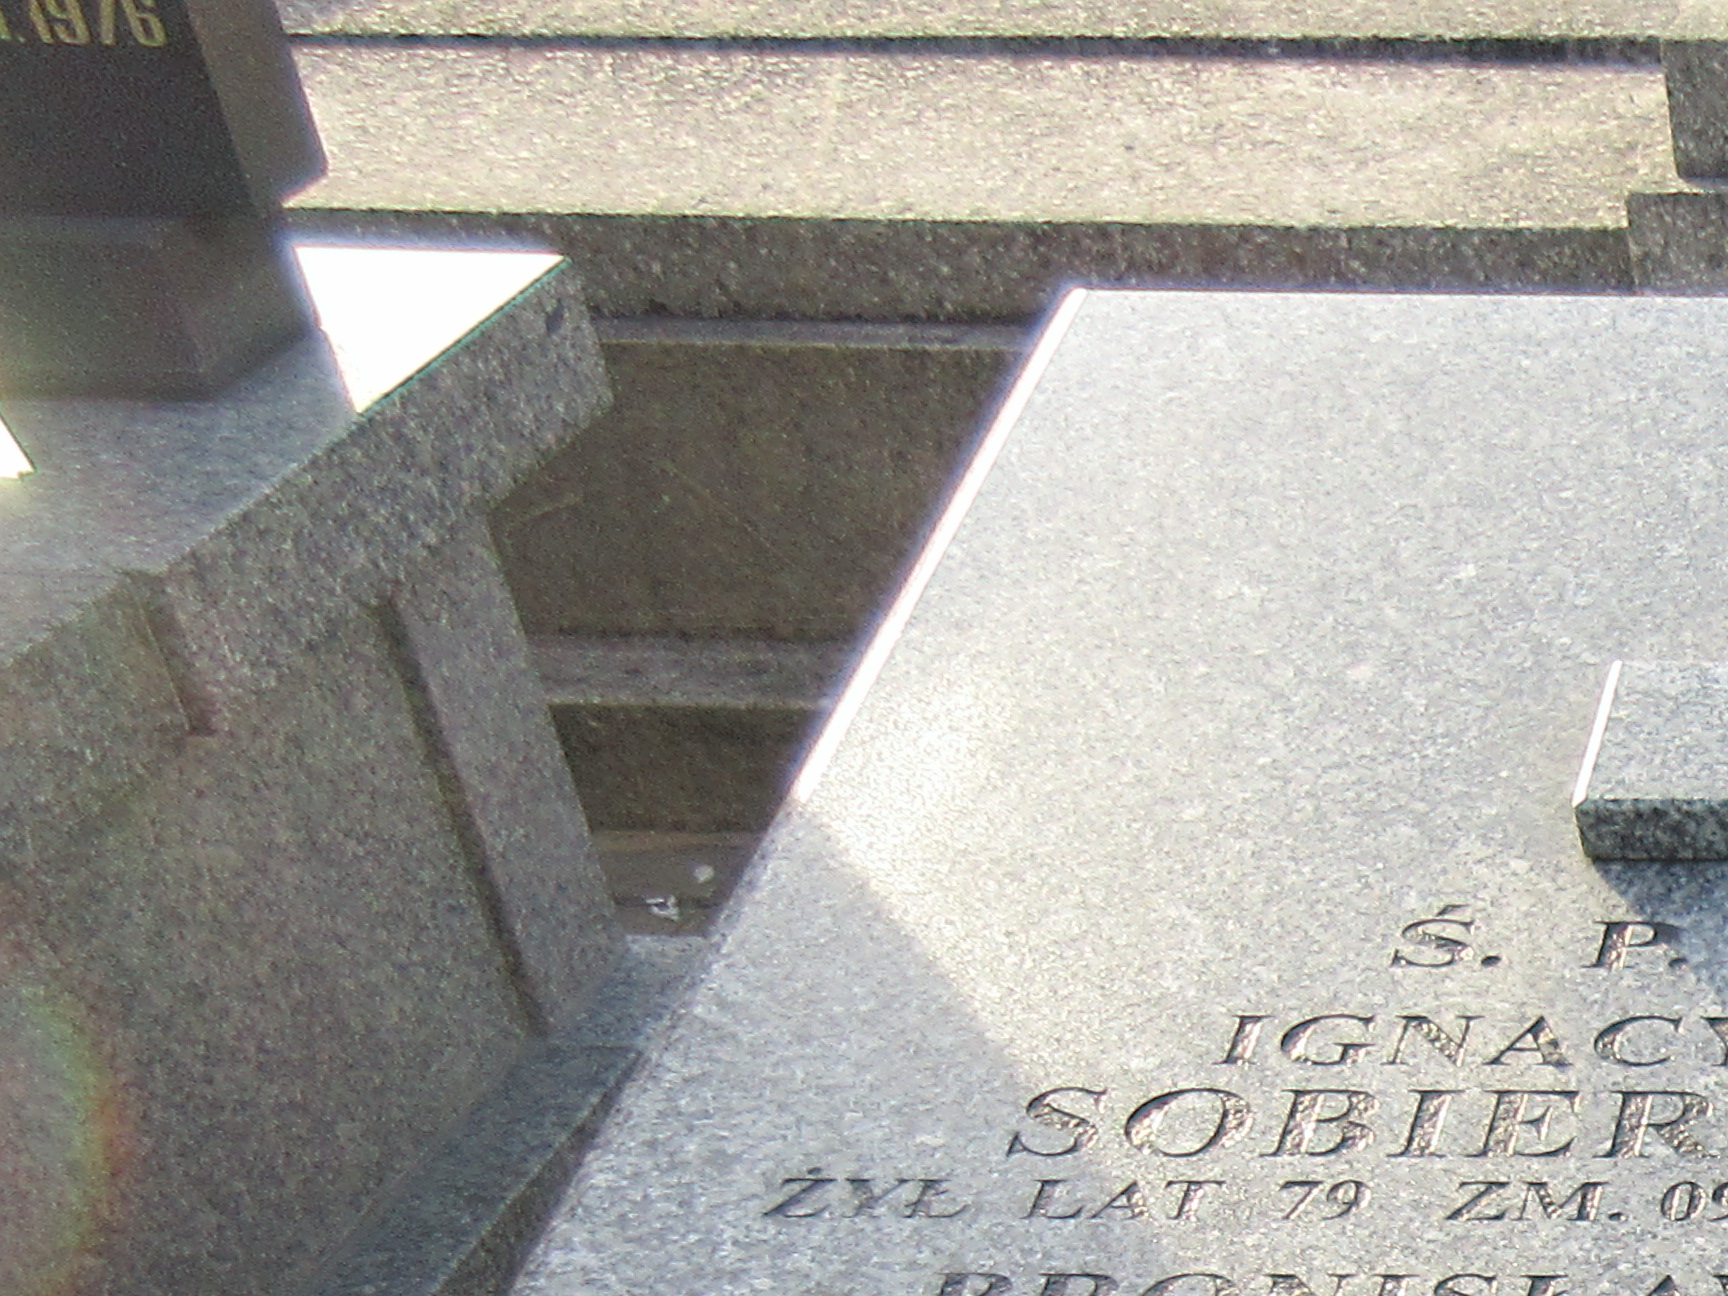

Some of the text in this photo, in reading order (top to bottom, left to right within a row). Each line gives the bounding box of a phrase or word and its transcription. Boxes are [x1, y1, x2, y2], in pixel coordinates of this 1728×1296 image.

[1392, 902, 1688, 970] Ś. P.
[760, 1168, 970, 1220] ŻYŁ
[1020, 1178, 1225, 1221] LAT
[1278, 1178, 1372, 1221] 79
[1446, 1180, 1626, 1222] ZM.
